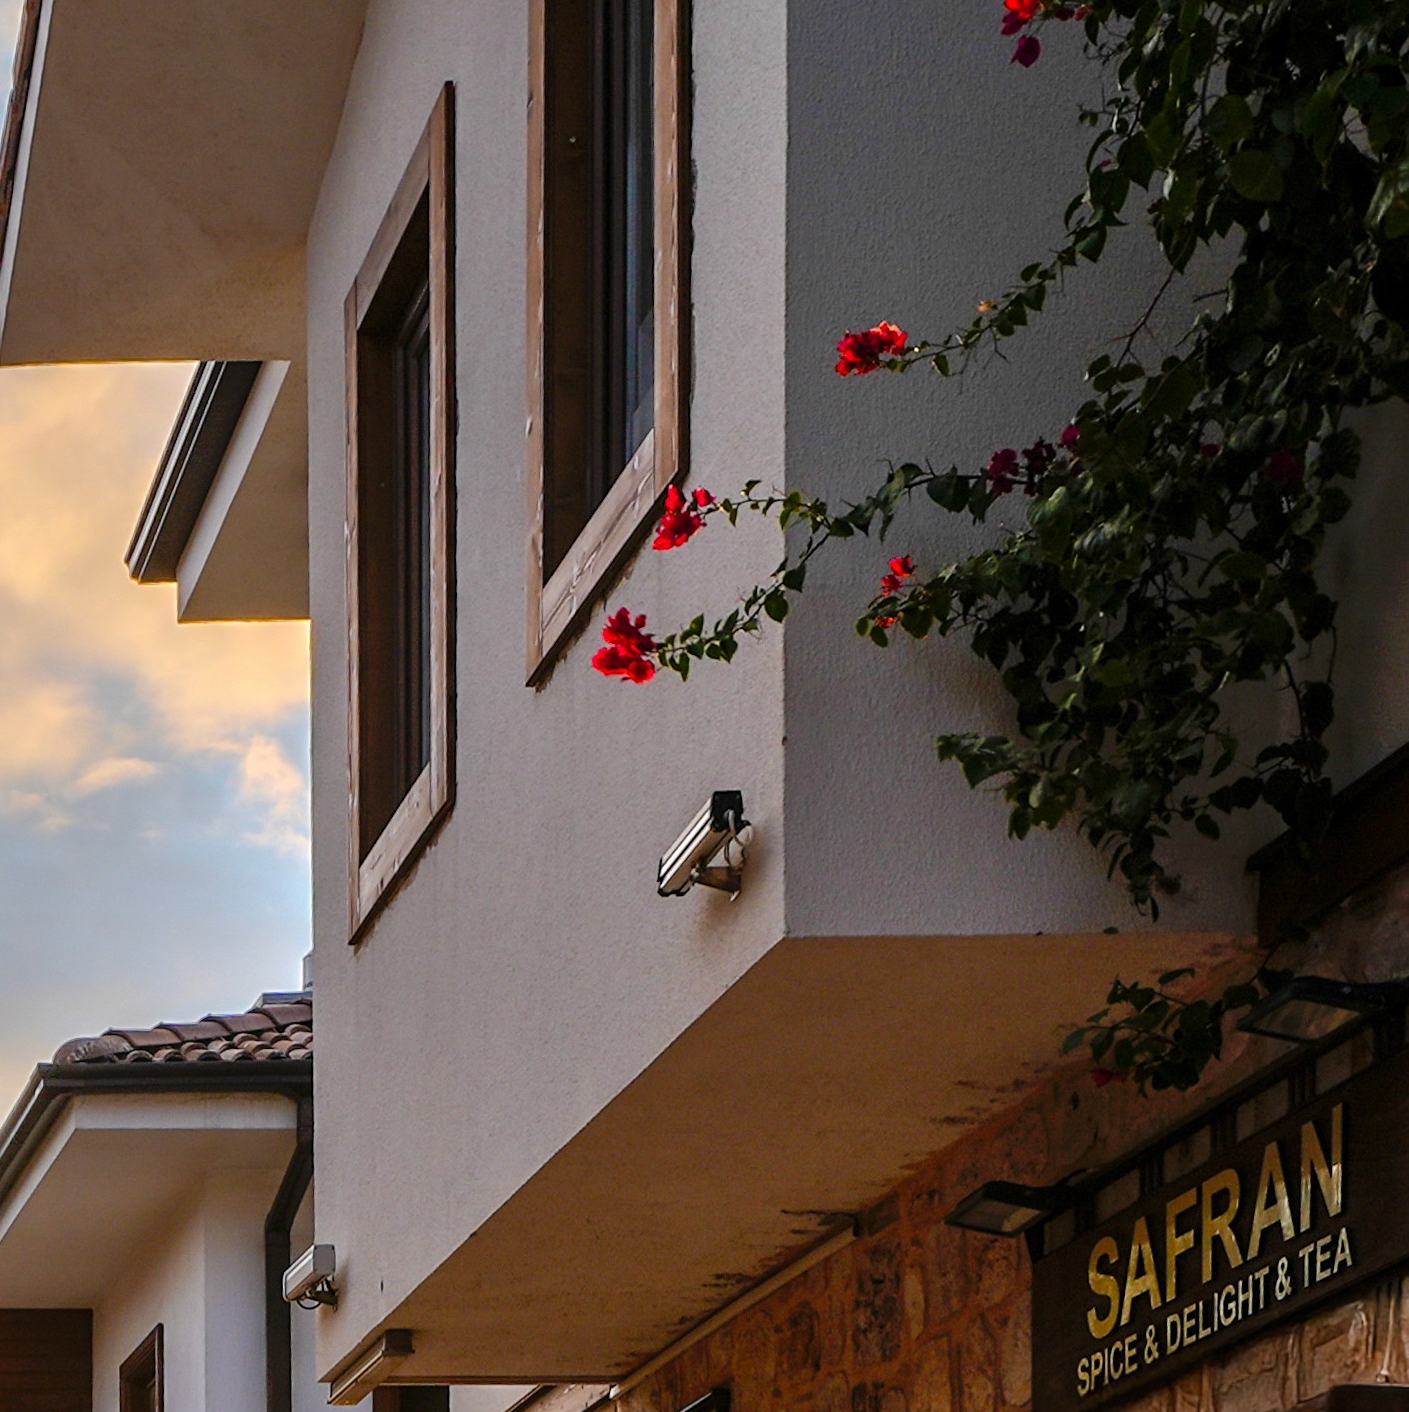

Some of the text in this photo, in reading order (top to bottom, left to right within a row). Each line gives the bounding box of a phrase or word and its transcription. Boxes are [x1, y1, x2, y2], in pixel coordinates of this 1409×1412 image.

[1076, 1225, 1354, 1398] SPICE & DELIGHT & TEA
[1085, 1102, 1344, 1340] SAFRAN
